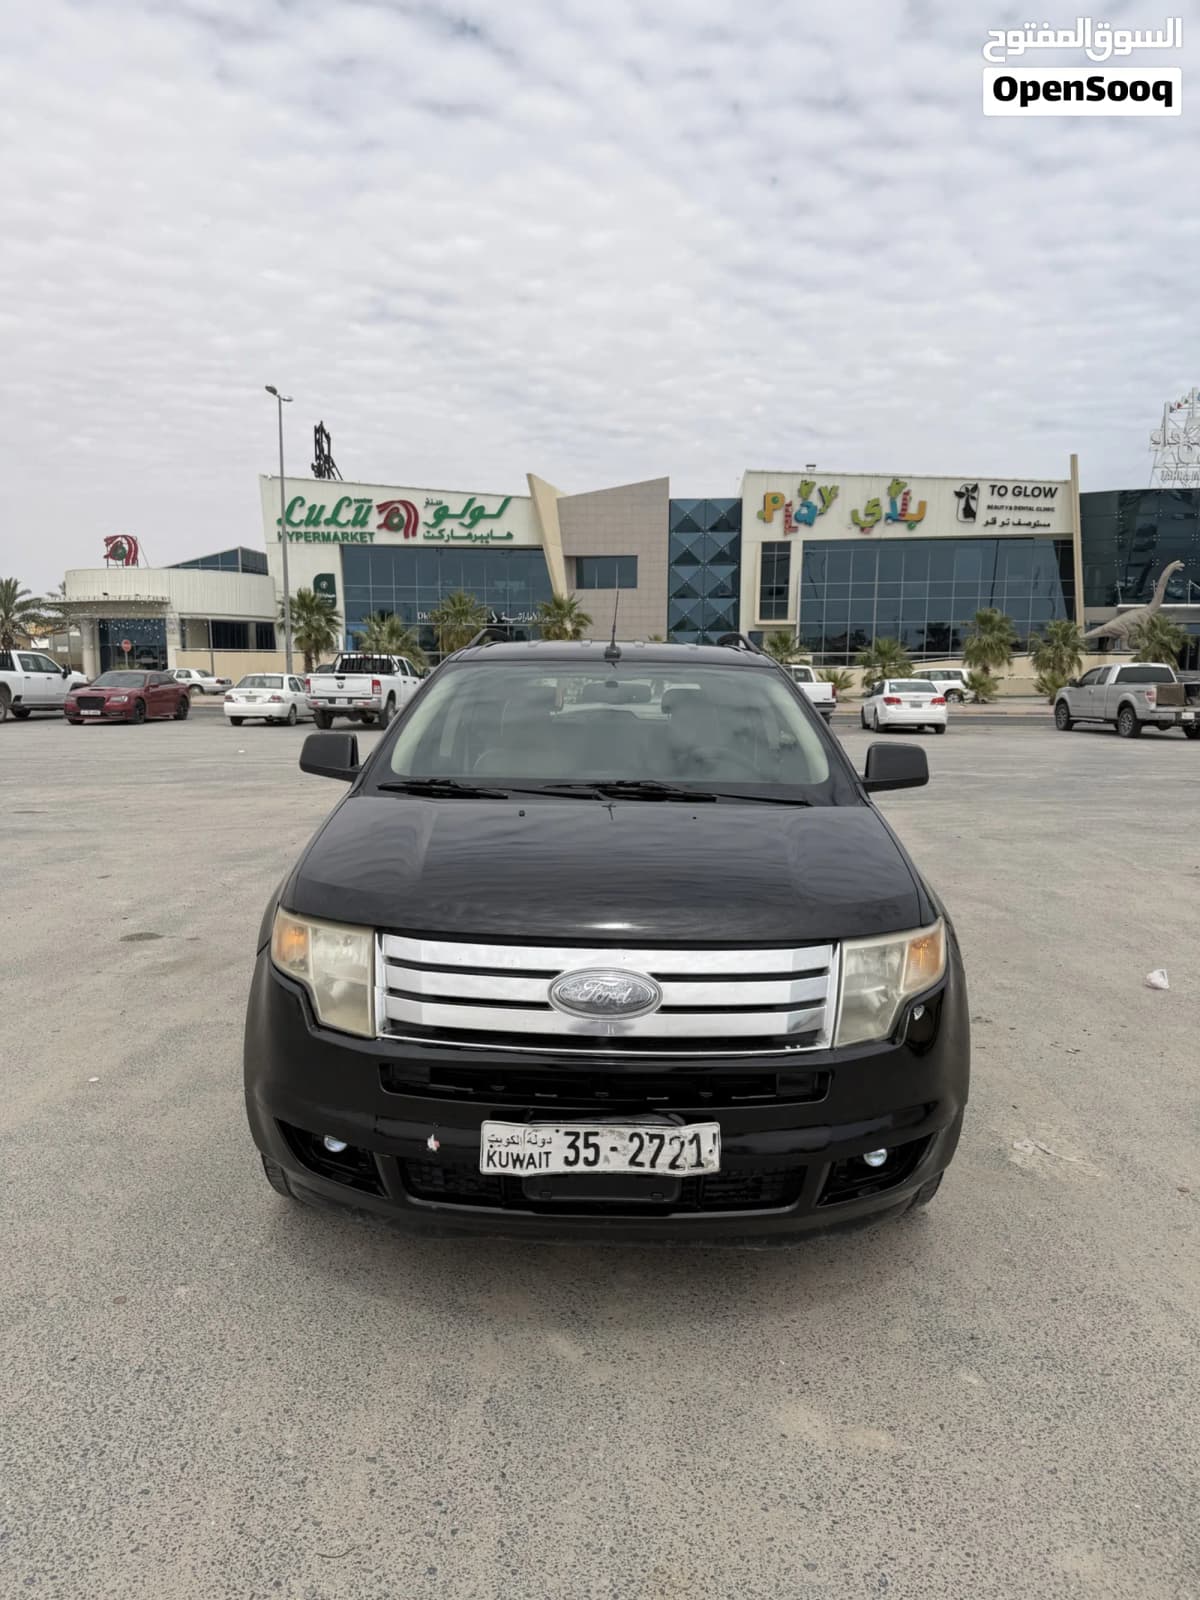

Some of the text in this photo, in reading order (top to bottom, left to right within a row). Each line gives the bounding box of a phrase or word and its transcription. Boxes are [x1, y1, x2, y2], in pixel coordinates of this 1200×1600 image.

[989, 484, 1058, 499] TO GLOW
[422, 496, 512, 529] لولو
[578, 980, 632, 1005] Ford
[486, 1149, 552, 1170] KUWAIT
